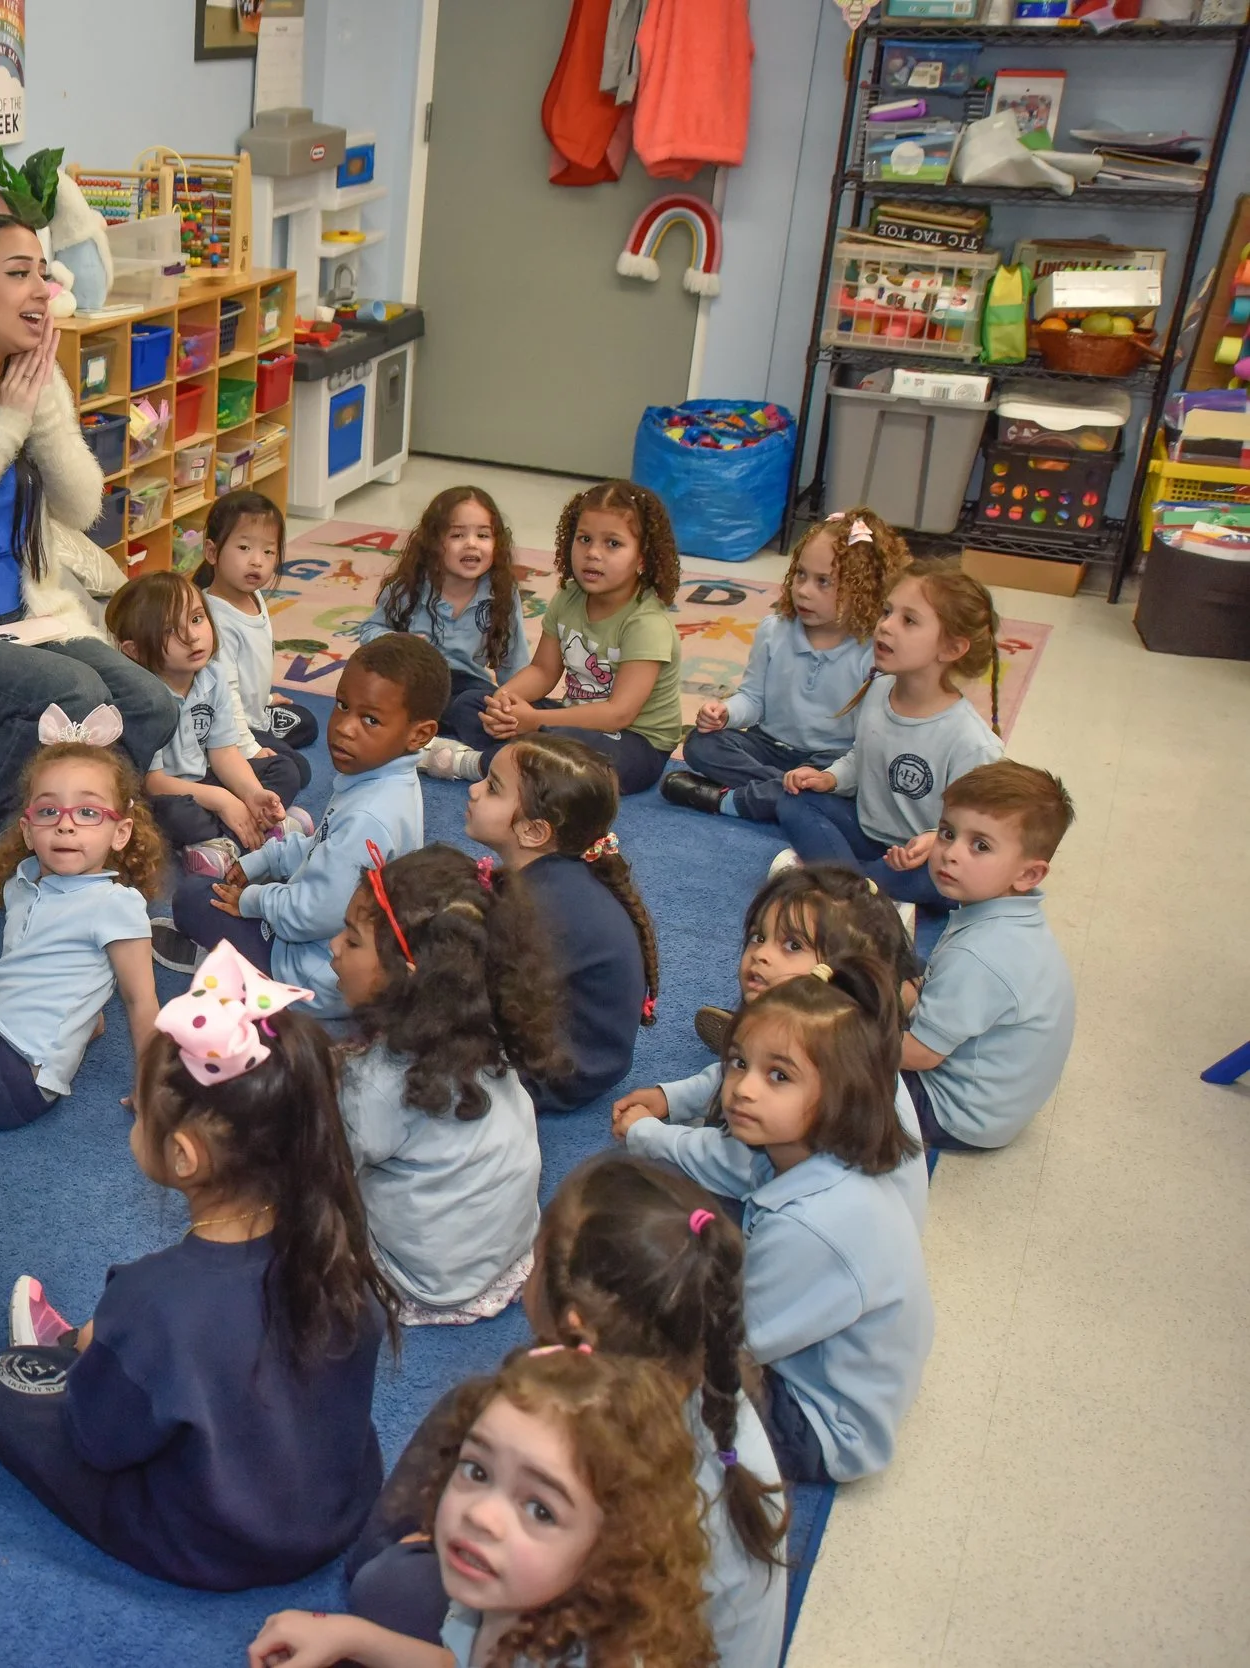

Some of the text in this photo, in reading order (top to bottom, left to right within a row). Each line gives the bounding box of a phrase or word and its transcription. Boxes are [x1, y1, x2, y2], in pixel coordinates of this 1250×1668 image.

[10, 96, 22, 110] THE
[878, 224, 979, 254] TIC TAC TOE
[282, 558, 330, 581] G
[685, 585, 747, 606] D
